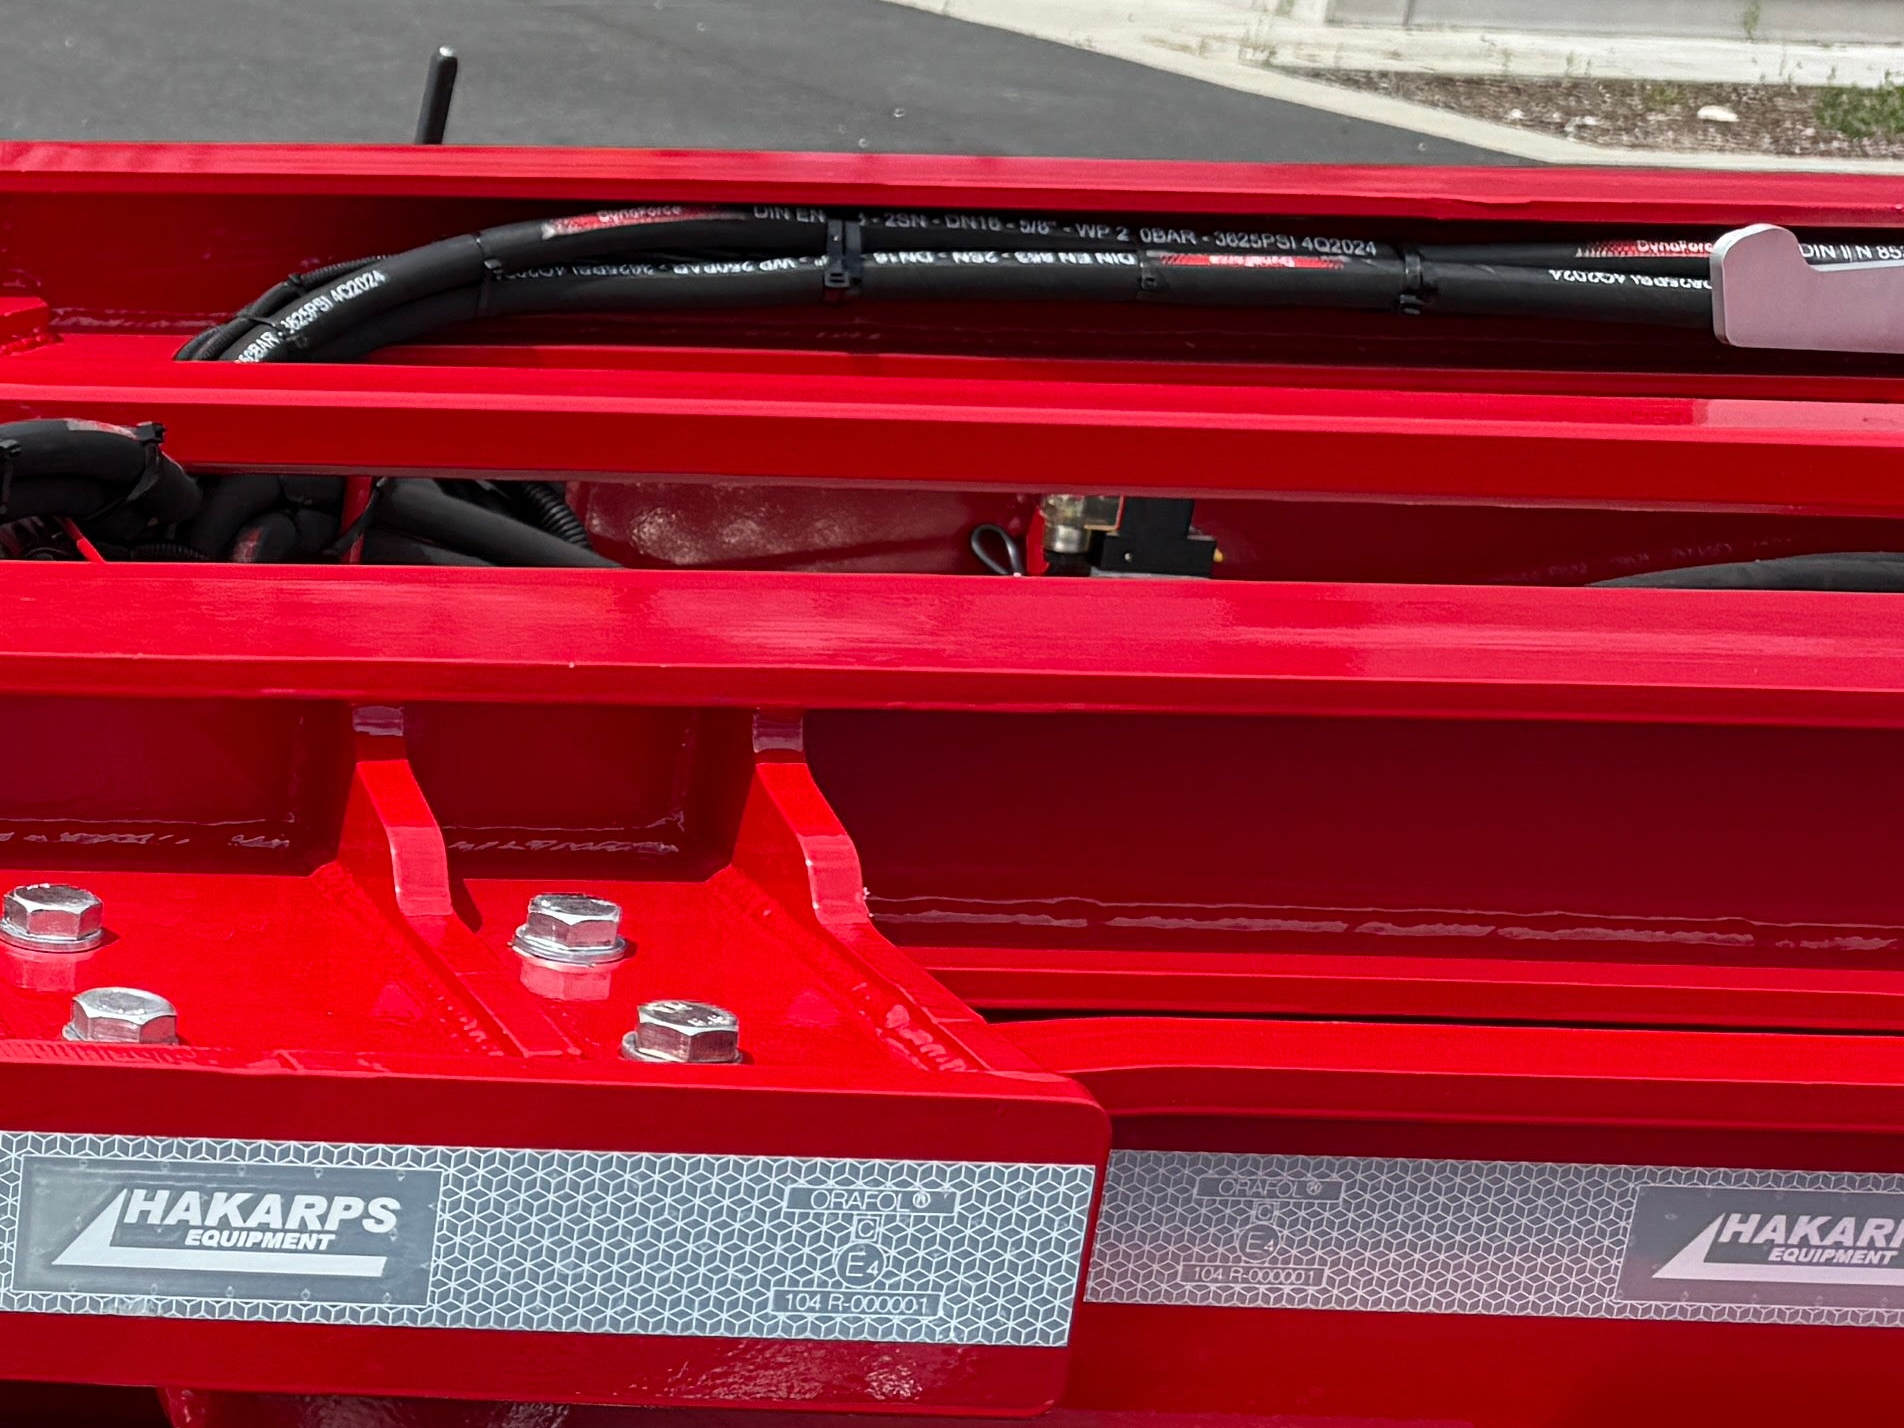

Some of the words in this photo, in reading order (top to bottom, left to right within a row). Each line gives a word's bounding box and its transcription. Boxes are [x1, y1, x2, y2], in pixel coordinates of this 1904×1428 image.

[1076, 224, 1110, 239] WP
[1214, 231, 1296, 251] 3625PSI
[1301, 237, 1377, 256] 4Q2024
[1799, 243, 1837, 259] DIN
[1876, 245, 1904, 260] 85
[122, 1187, 402, 1234] HAKARPS
[184, 1228, 337, 1251] EQUIPMENT
[1767, 1246, 1898, 1266] EQUIPMENT
[1193, 1264, 1224, 1281] 104
[784, 1292, 821, 1312] 104
